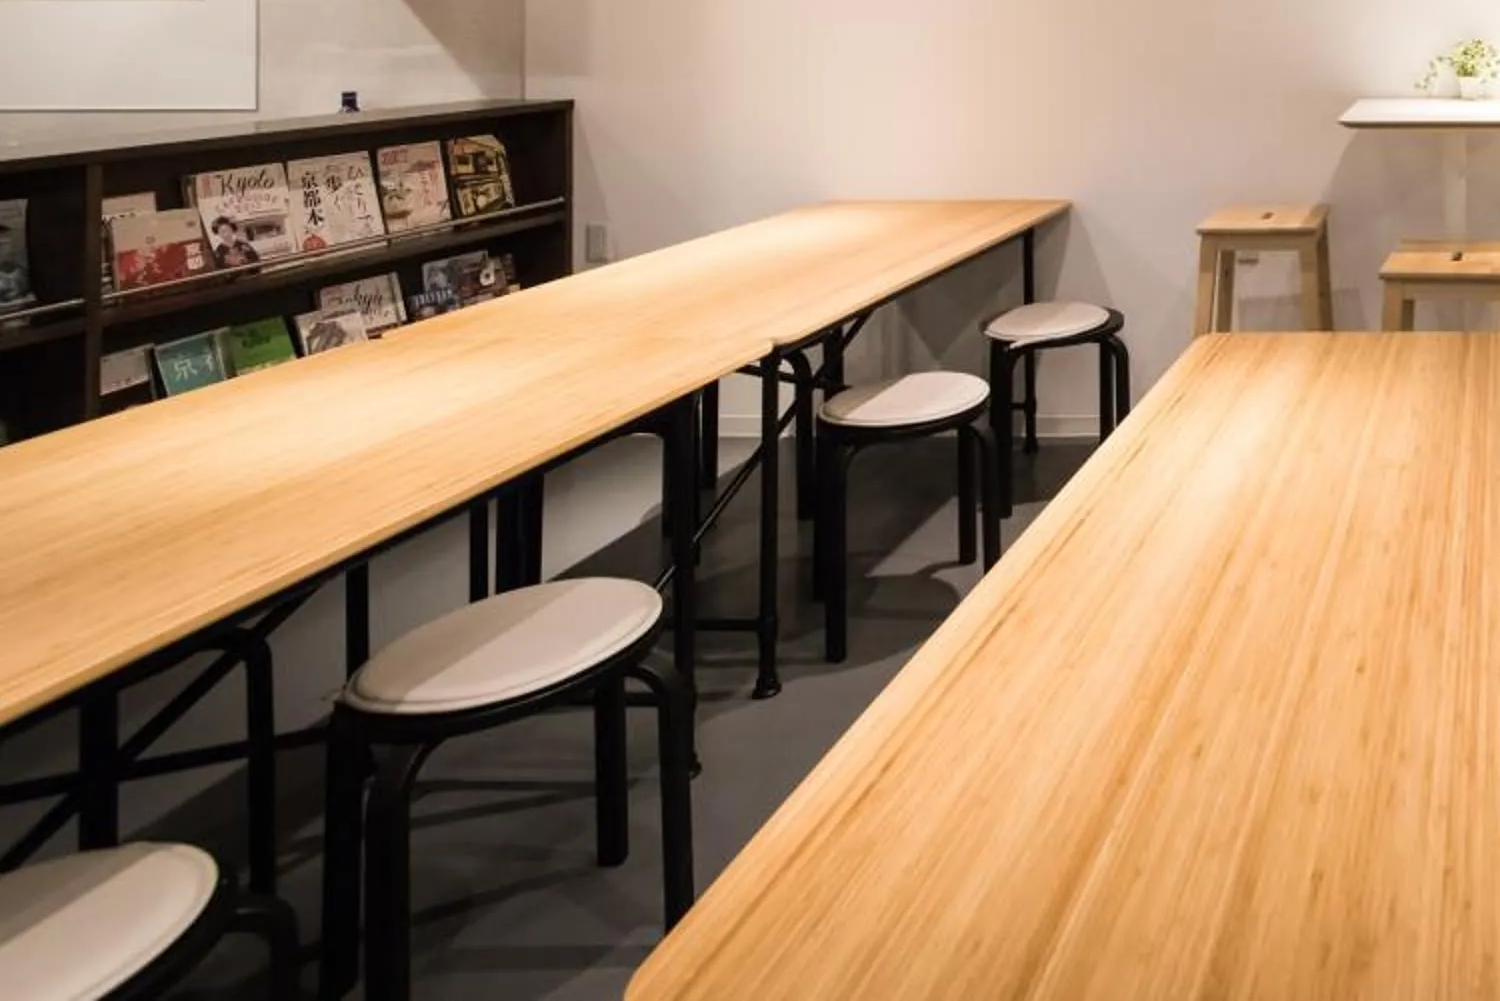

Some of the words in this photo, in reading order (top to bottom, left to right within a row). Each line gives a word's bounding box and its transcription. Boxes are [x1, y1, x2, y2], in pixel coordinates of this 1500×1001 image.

[221, 168, 275, 197] Kyoto
[301, 170, 325, 226] 京都本
